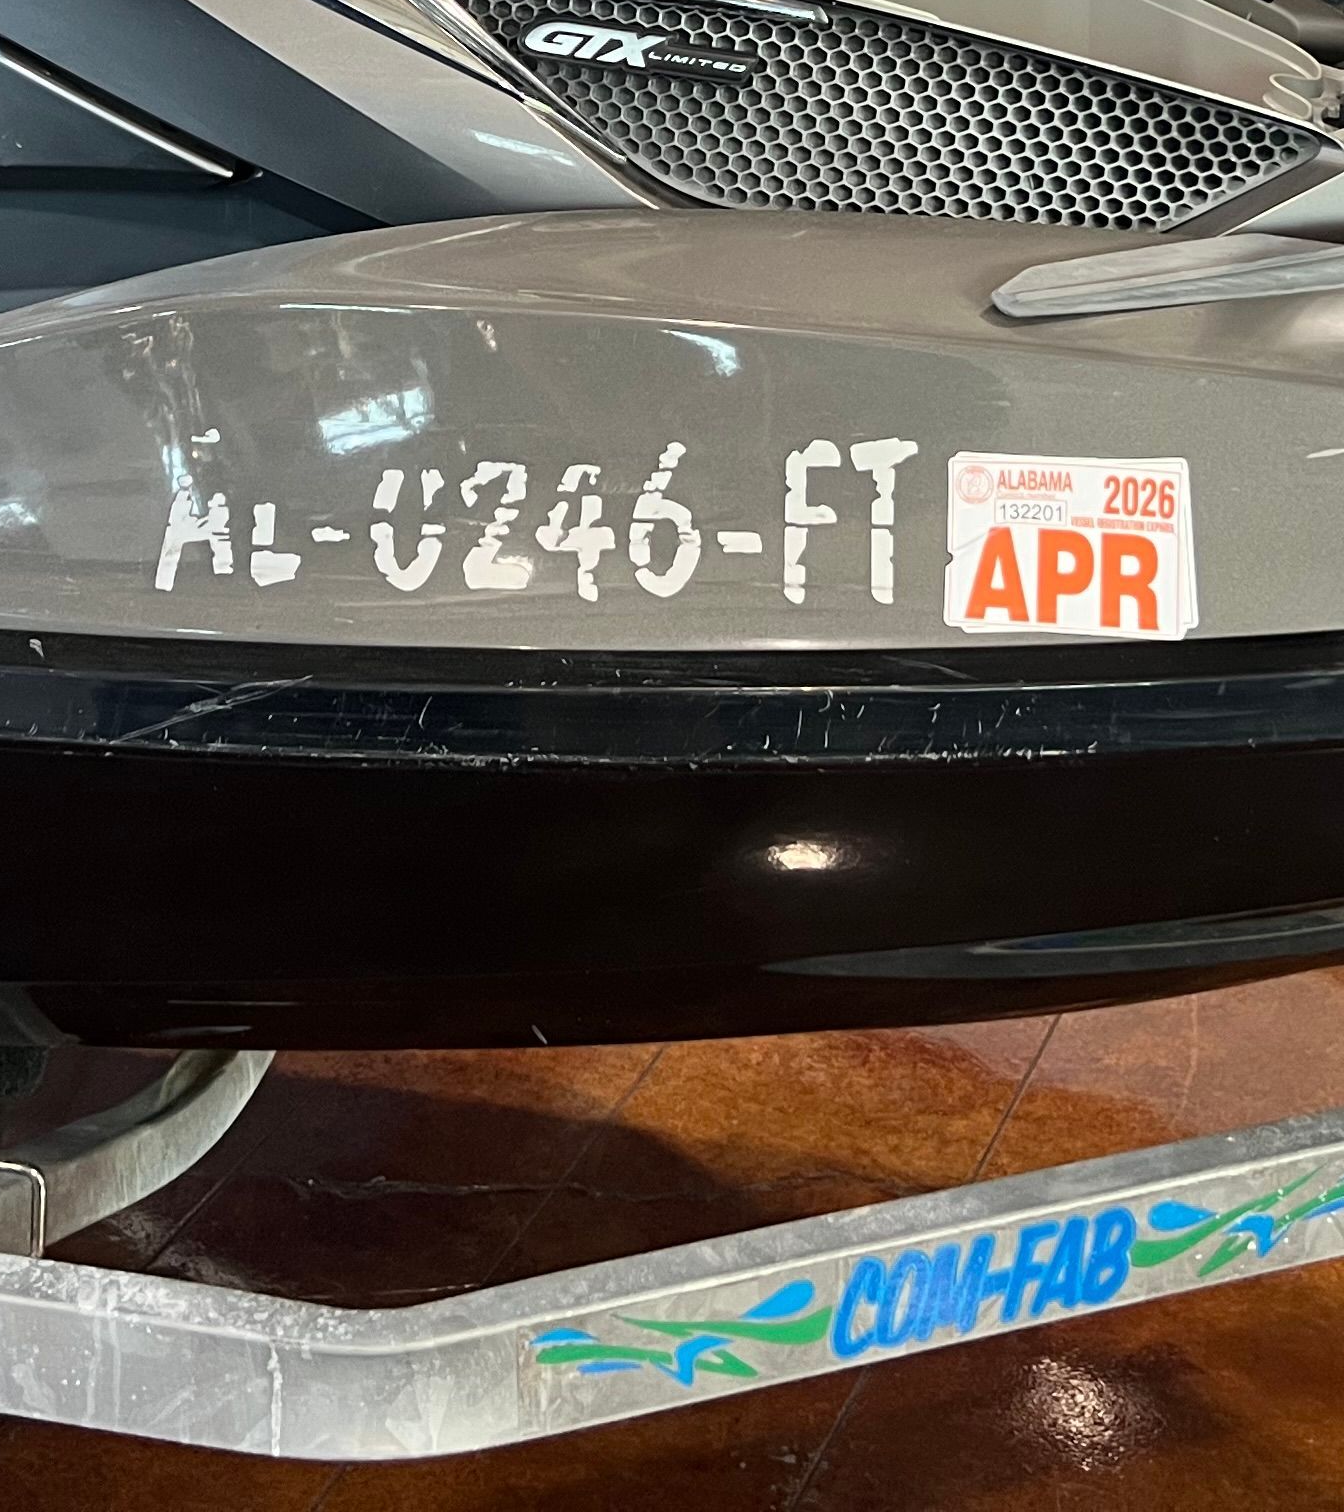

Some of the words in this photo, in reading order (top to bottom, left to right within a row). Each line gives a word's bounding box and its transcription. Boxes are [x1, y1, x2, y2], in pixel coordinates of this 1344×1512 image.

[524, 21, 667, 68] GTX
[648, 50, 747, 73] LIMITED
[996, 469, 1074, 493] ALABAMA
[1102, 474, 1176, 520] 2026
[999, 503, 1063, 523] 132201
[964, 525, 1160, 632] APR
[830, 1206, 1137, 1360] COM-FAB
